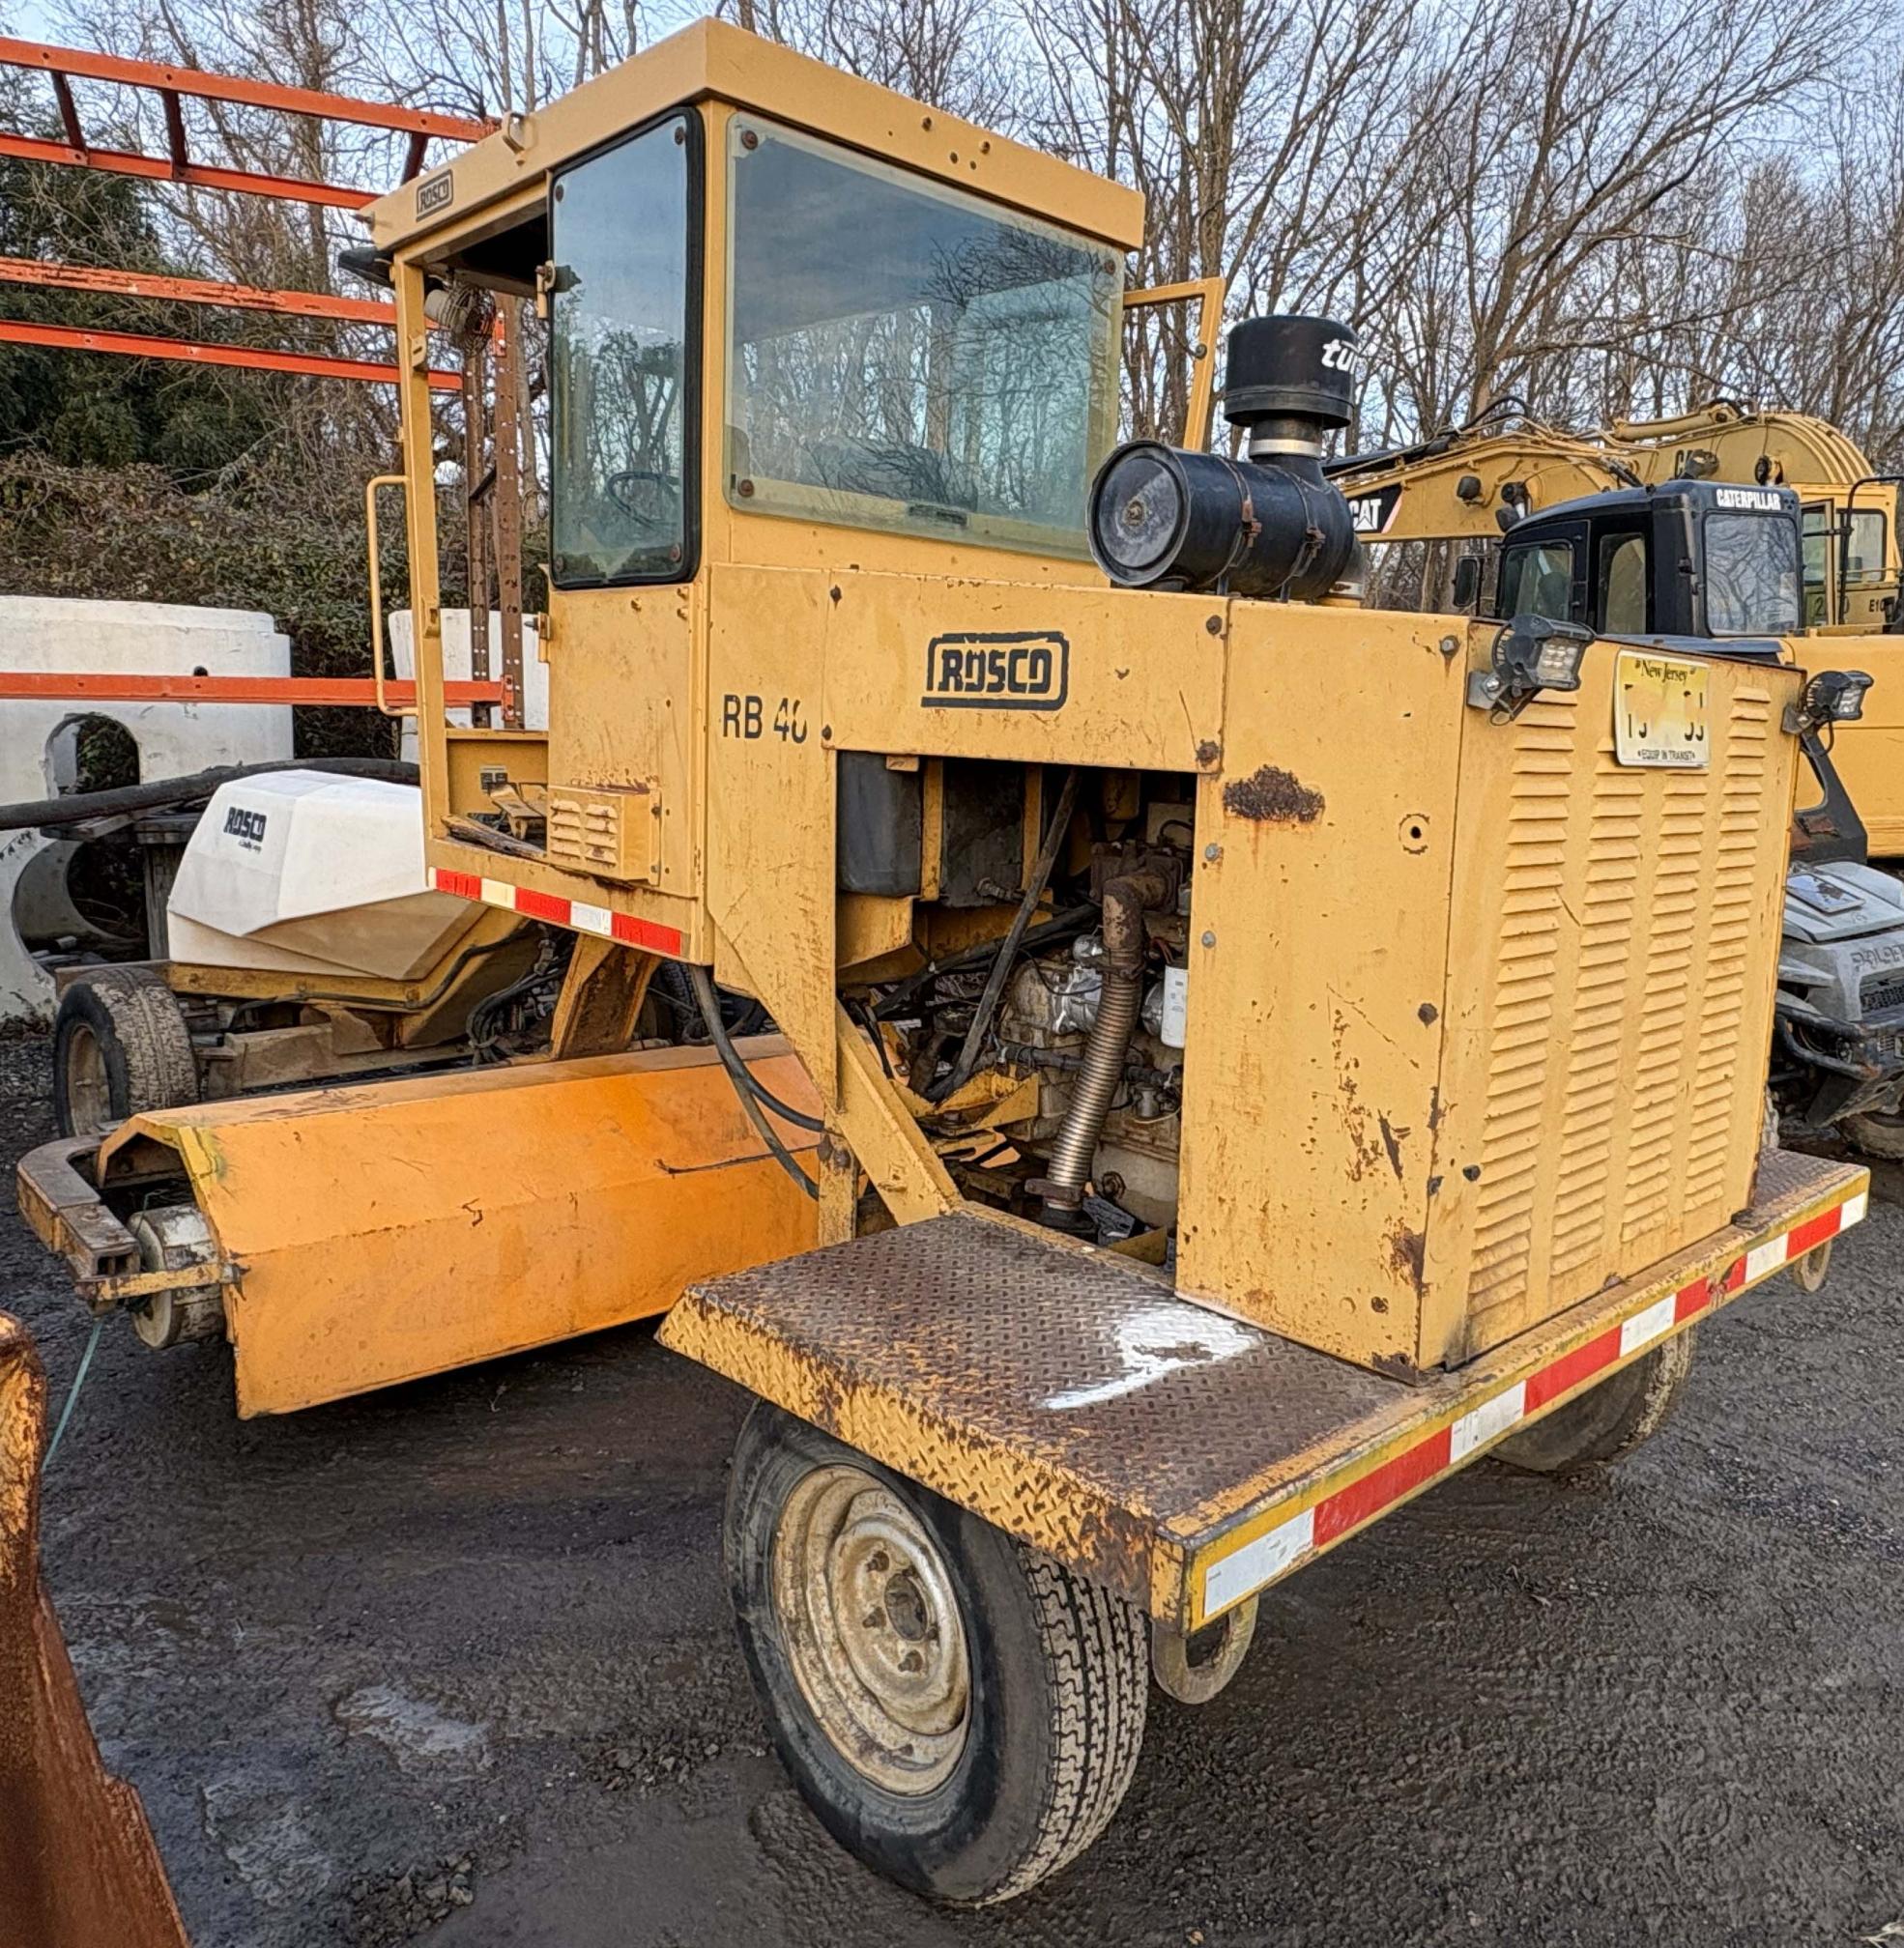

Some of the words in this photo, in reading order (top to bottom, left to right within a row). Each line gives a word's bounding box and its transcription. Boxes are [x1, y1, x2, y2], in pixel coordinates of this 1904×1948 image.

[419, 178, 449, 212] ROSCO
[1348, 499, 1382, 531] CAT
[1716, 489, 1781, 510] CATERPILLAR
[938, 648, 1053, 694] ROSCO
[1641, 659, 1662, 678] New
[1662, 662, 1688, 686] Jersey
[723, 694, 763, 738] RB
[223, 807, 267, 843] ROSCO
